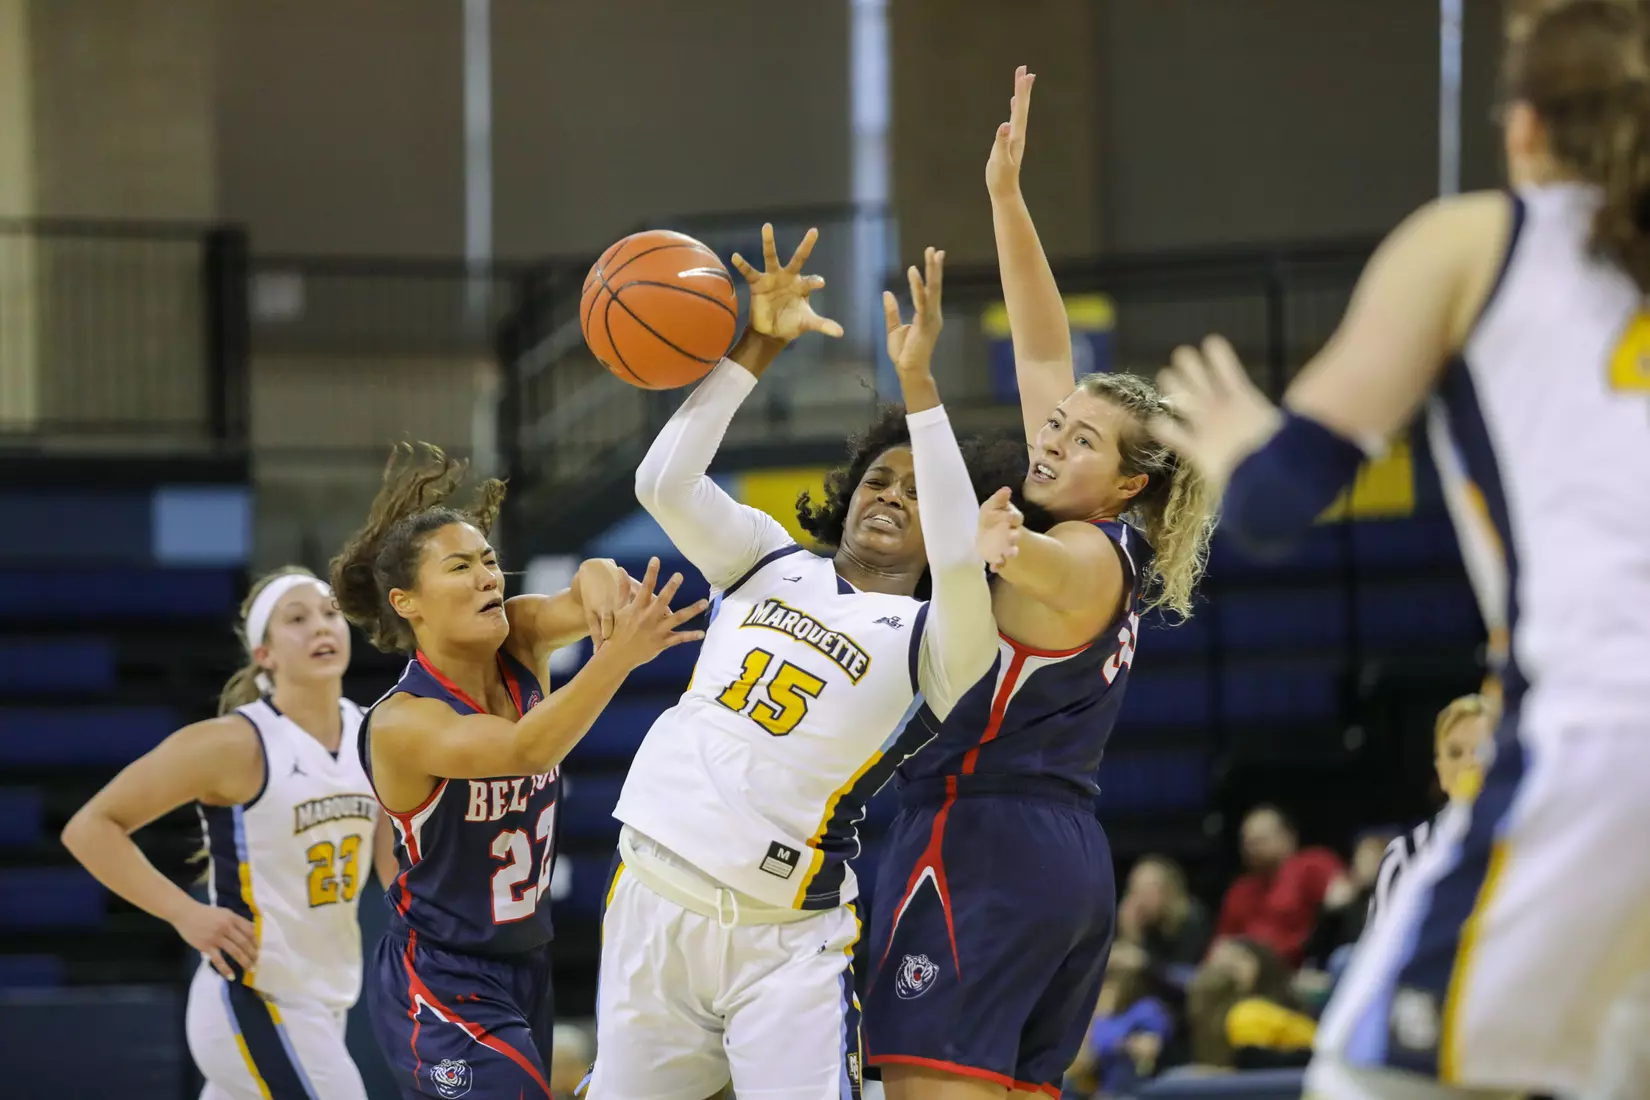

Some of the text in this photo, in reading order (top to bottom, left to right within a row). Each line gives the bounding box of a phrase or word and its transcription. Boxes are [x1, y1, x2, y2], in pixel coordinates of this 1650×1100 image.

[741, 598, 871, 685] MARQUETTE
[715, 647, 827, 736] 15
[308, 834, 361, 907] 23
[490, 802, 556, 925] 22
[777, 847, 791, 860] M
